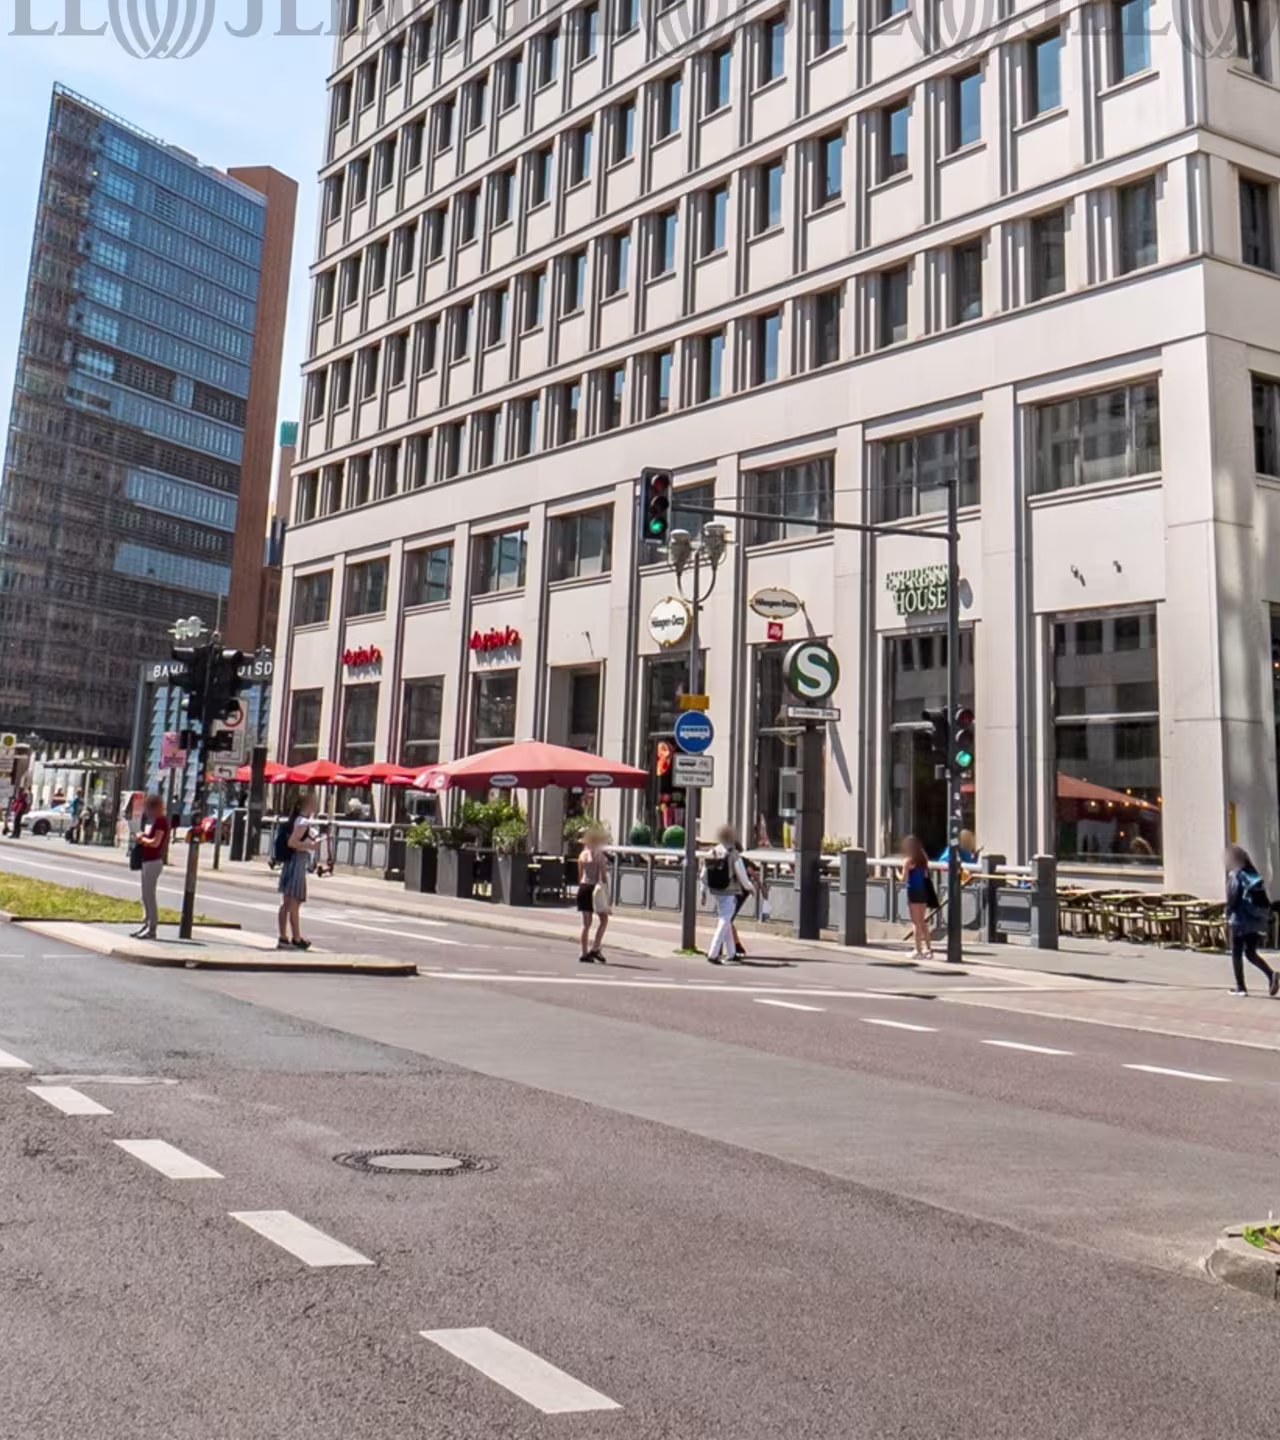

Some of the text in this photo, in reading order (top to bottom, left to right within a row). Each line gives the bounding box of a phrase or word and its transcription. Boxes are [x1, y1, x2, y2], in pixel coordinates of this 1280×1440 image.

[886, 564, 948, 591] ESPRESS
[894, 587, 947, 615] HOUSE
[797, 646, 832, 697] S
